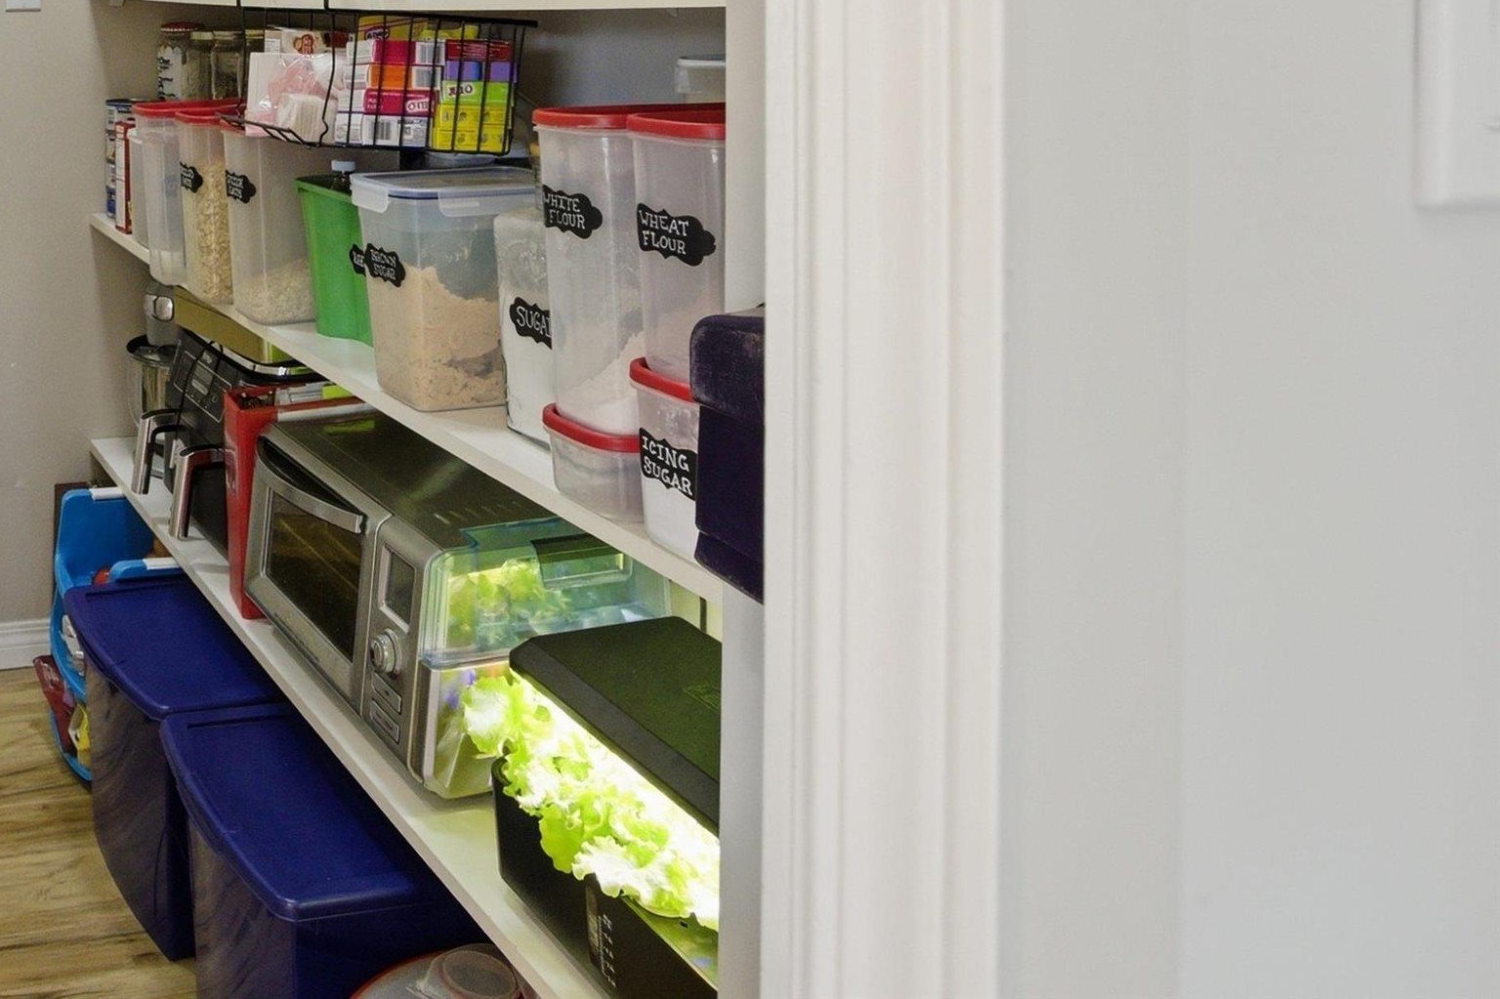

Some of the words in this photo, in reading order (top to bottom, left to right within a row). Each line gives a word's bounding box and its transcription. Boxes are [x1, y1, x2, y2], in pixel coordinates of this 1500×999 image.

[543, 192, 582, 214] WHITE
[549, 208, 586, 231] FLOUR
[639, 209, 690, 237] WHEAT
[642, 231, 688, 256] FLOUR
[641, 435, 690, 473] ICING
[642, 455, 694, 497] SUGAR
